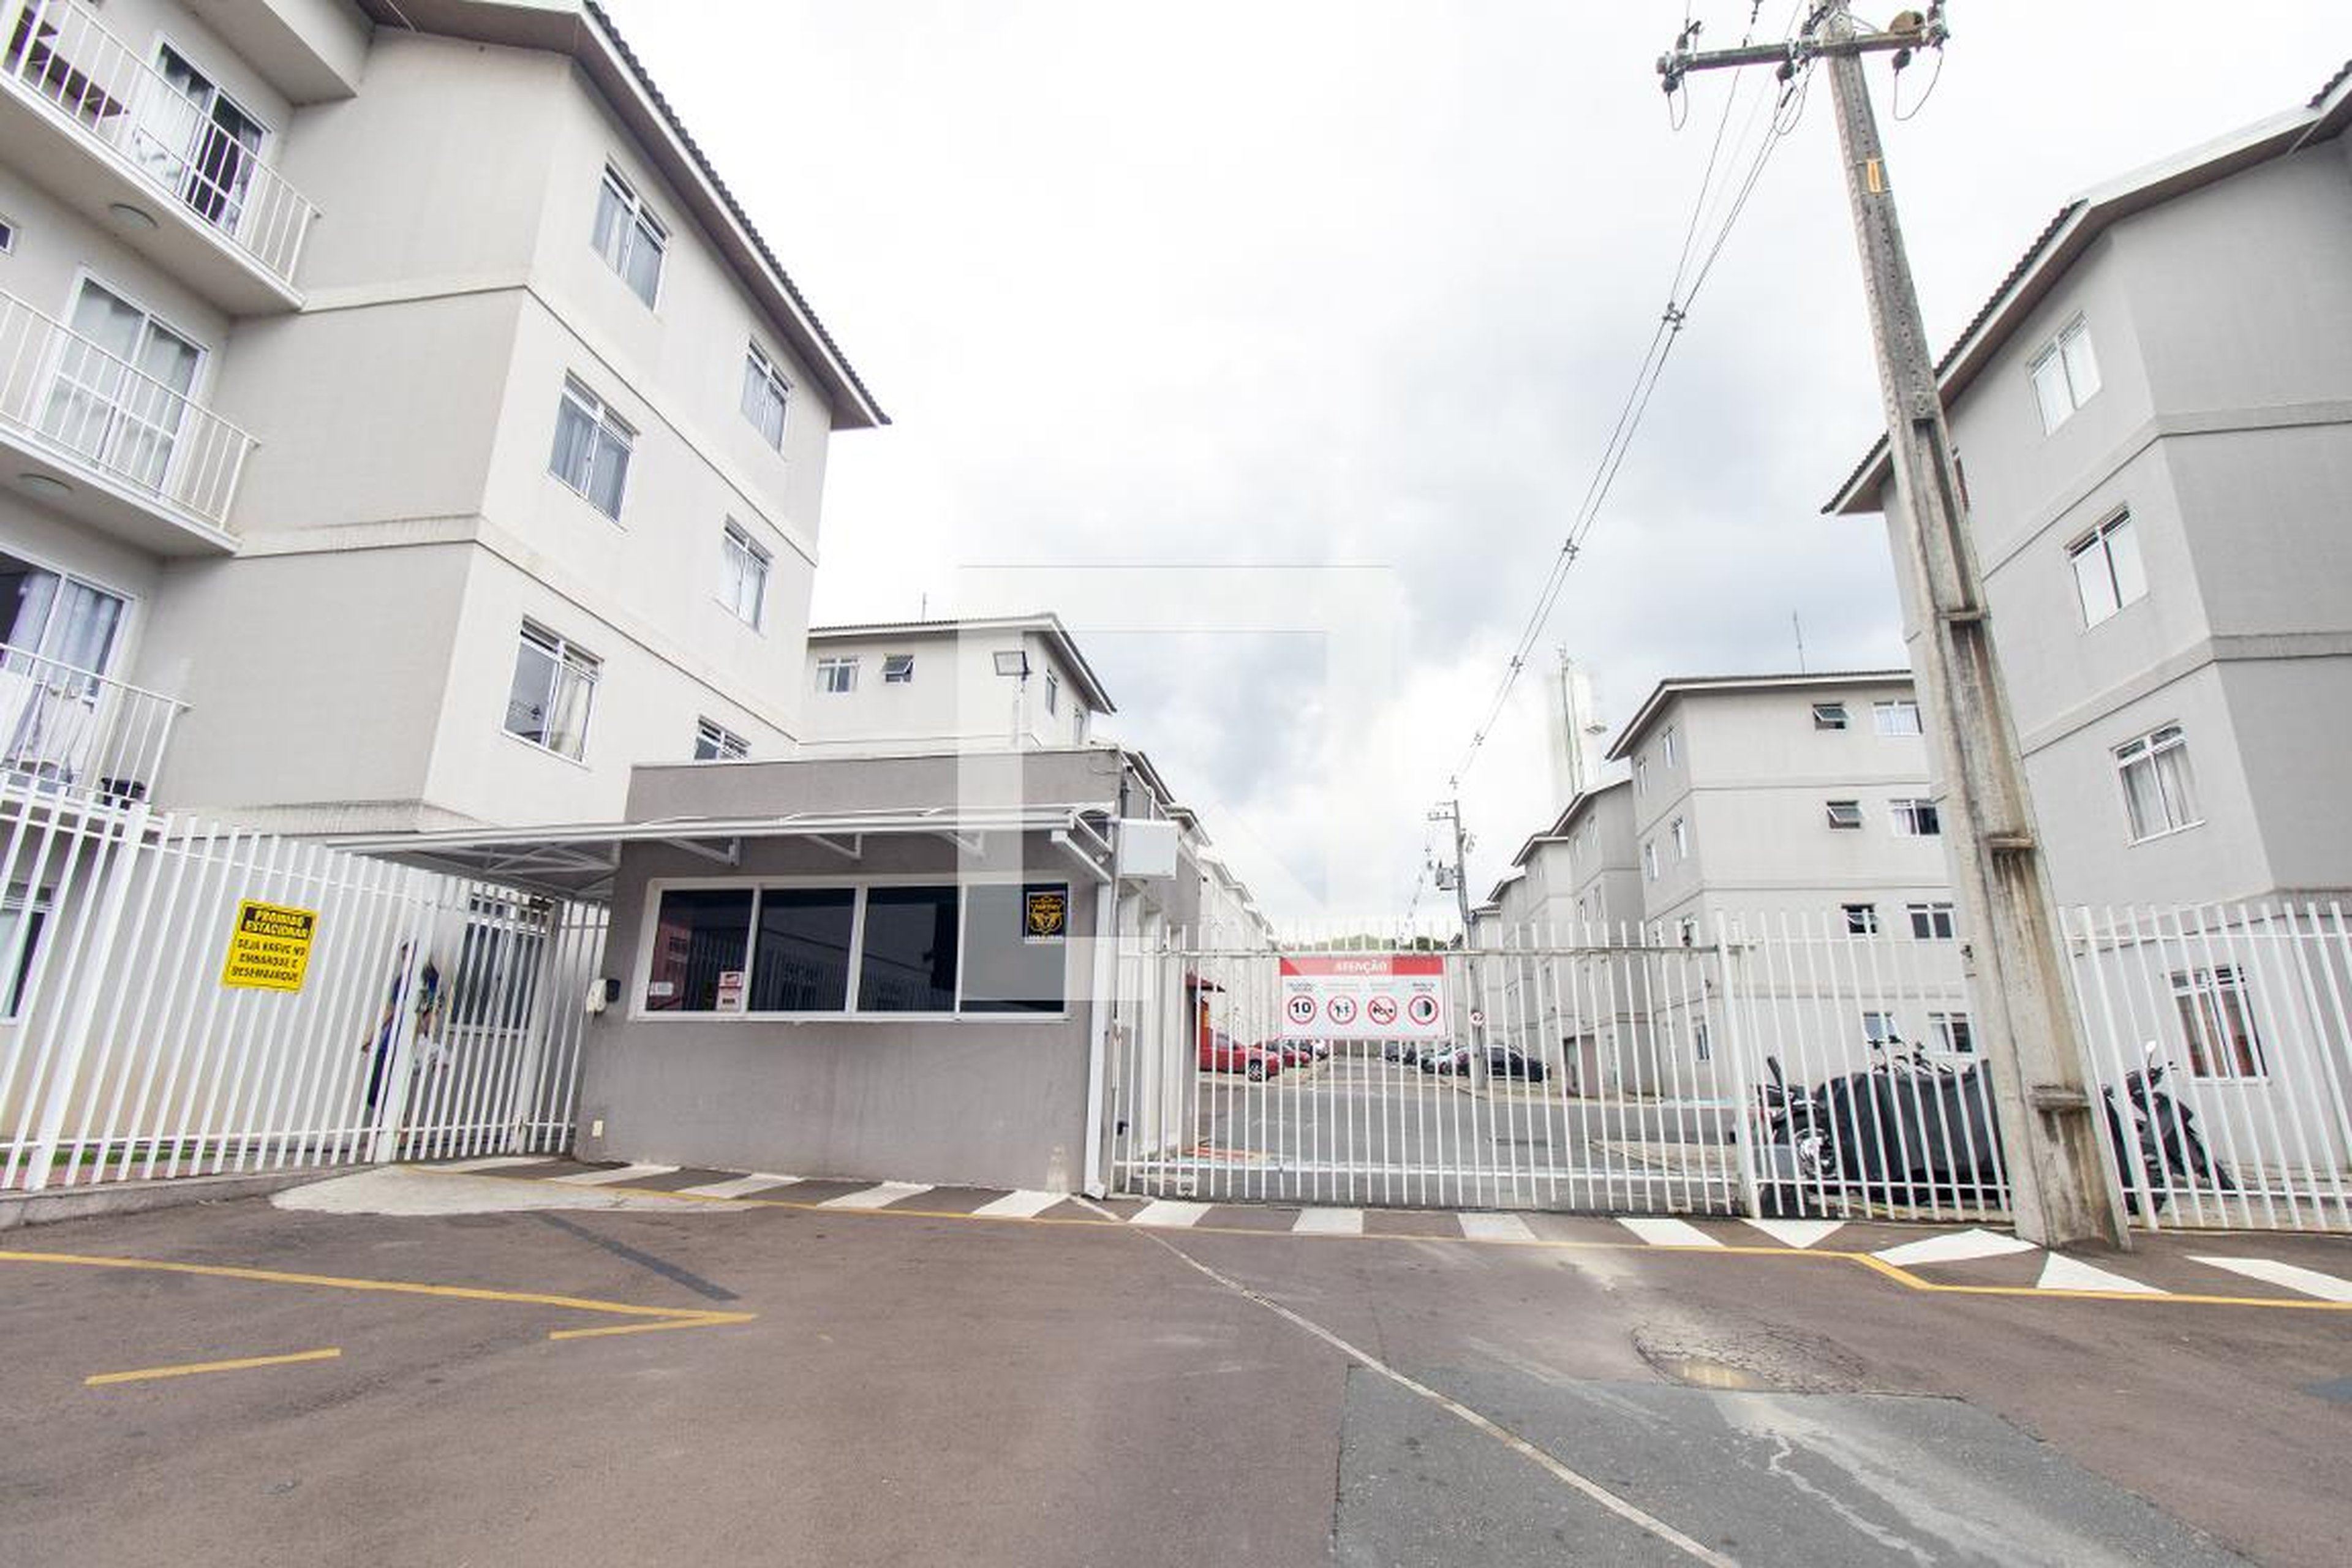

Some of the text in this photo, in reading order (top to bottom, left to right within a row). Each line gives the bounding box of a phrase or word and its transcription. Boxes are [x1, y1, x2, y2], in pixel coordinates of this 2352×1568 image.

[245, 920, 309, 938] ESTACIONAR
[237, 938, 261, 951] SEJA
[1335, 959, 1387, 974] ATENÇÃO
[1292, 1001, 1311, 1013] 10
